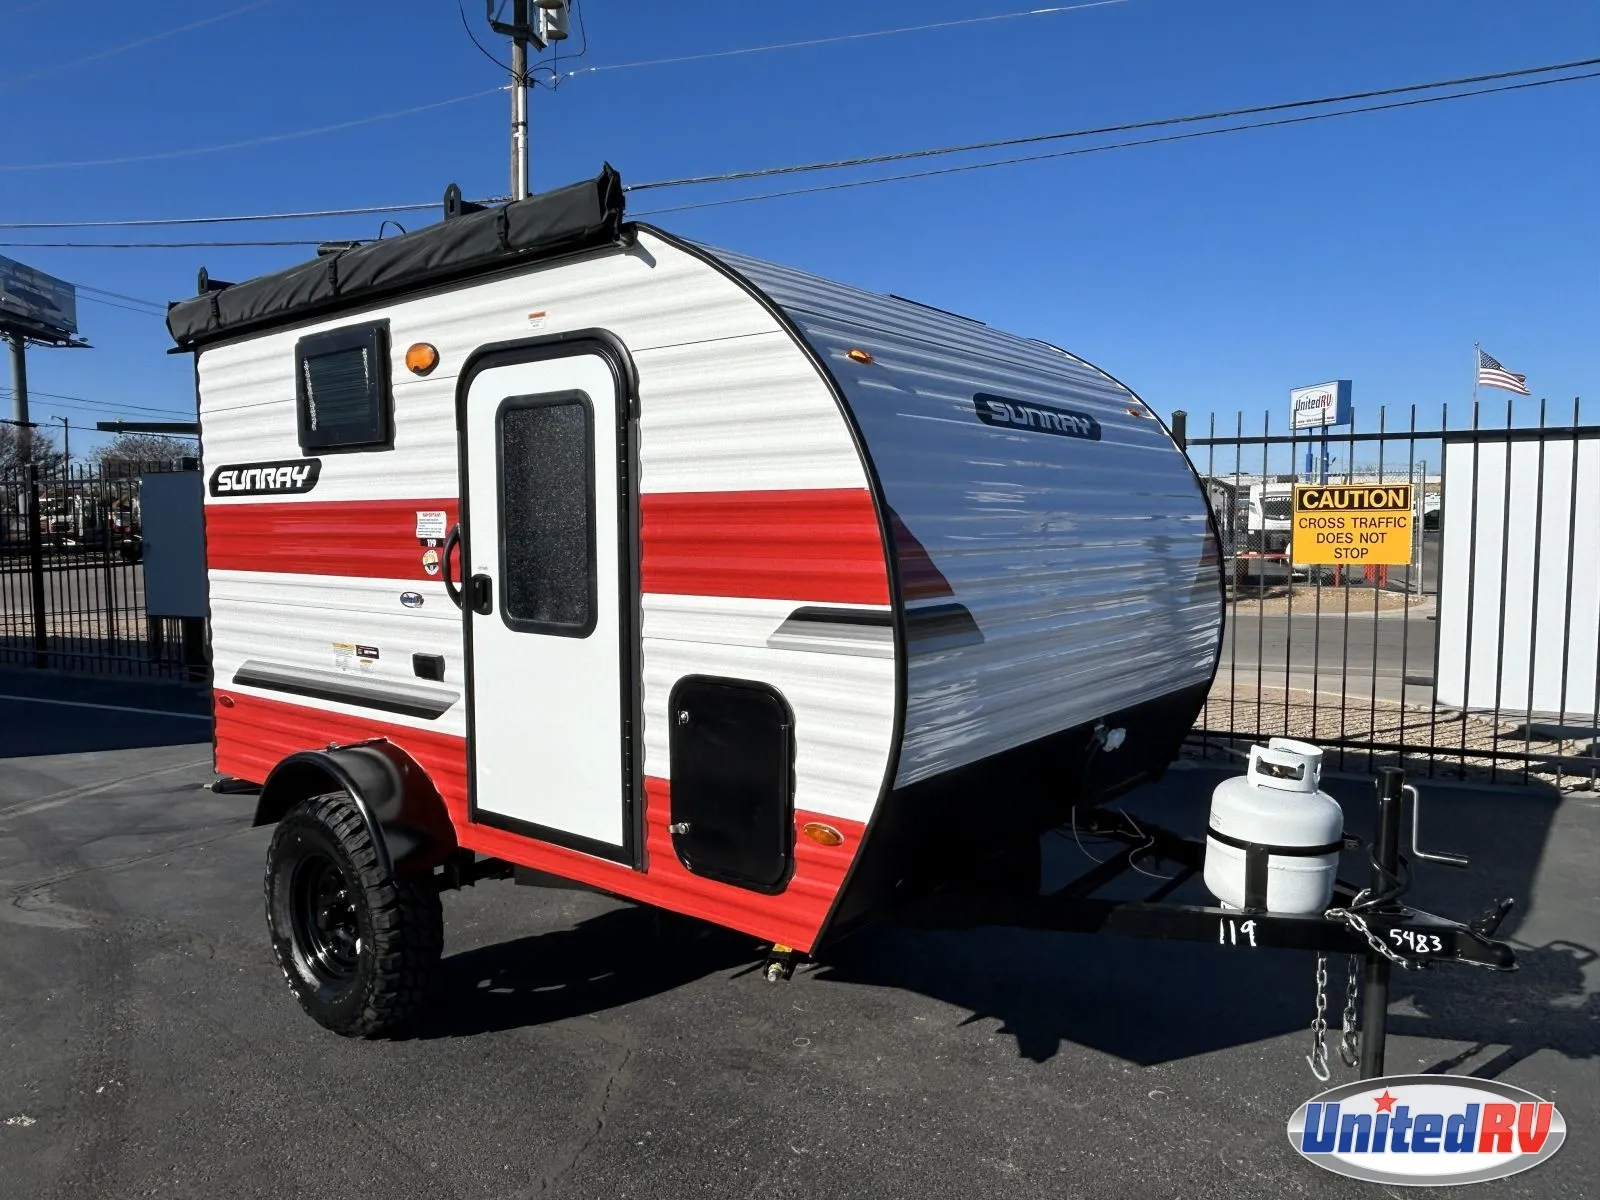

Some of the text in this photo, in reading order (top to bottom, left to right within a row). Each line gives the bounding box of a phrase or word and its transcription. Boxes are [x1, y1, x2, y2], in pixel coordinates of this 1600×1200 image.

[1295, 394, 1332, 411] UnitedRV
[986, 400, 1091, 434] SUNRAY
[218, 465, 311, 491] SUNRAY
[1302, 489, 1404, 508] CAUTION
[1299, 516, 1407, 528] CROSS TRAFFIC
[426, 538, 437, 547] 119
[1316, 532, 1387, 543] DOES NOT
[1334, 547, 1369, 558] STOP
[1219, 918, 1256, 947] 119
[1389, 928, 1443, 953] 5483
